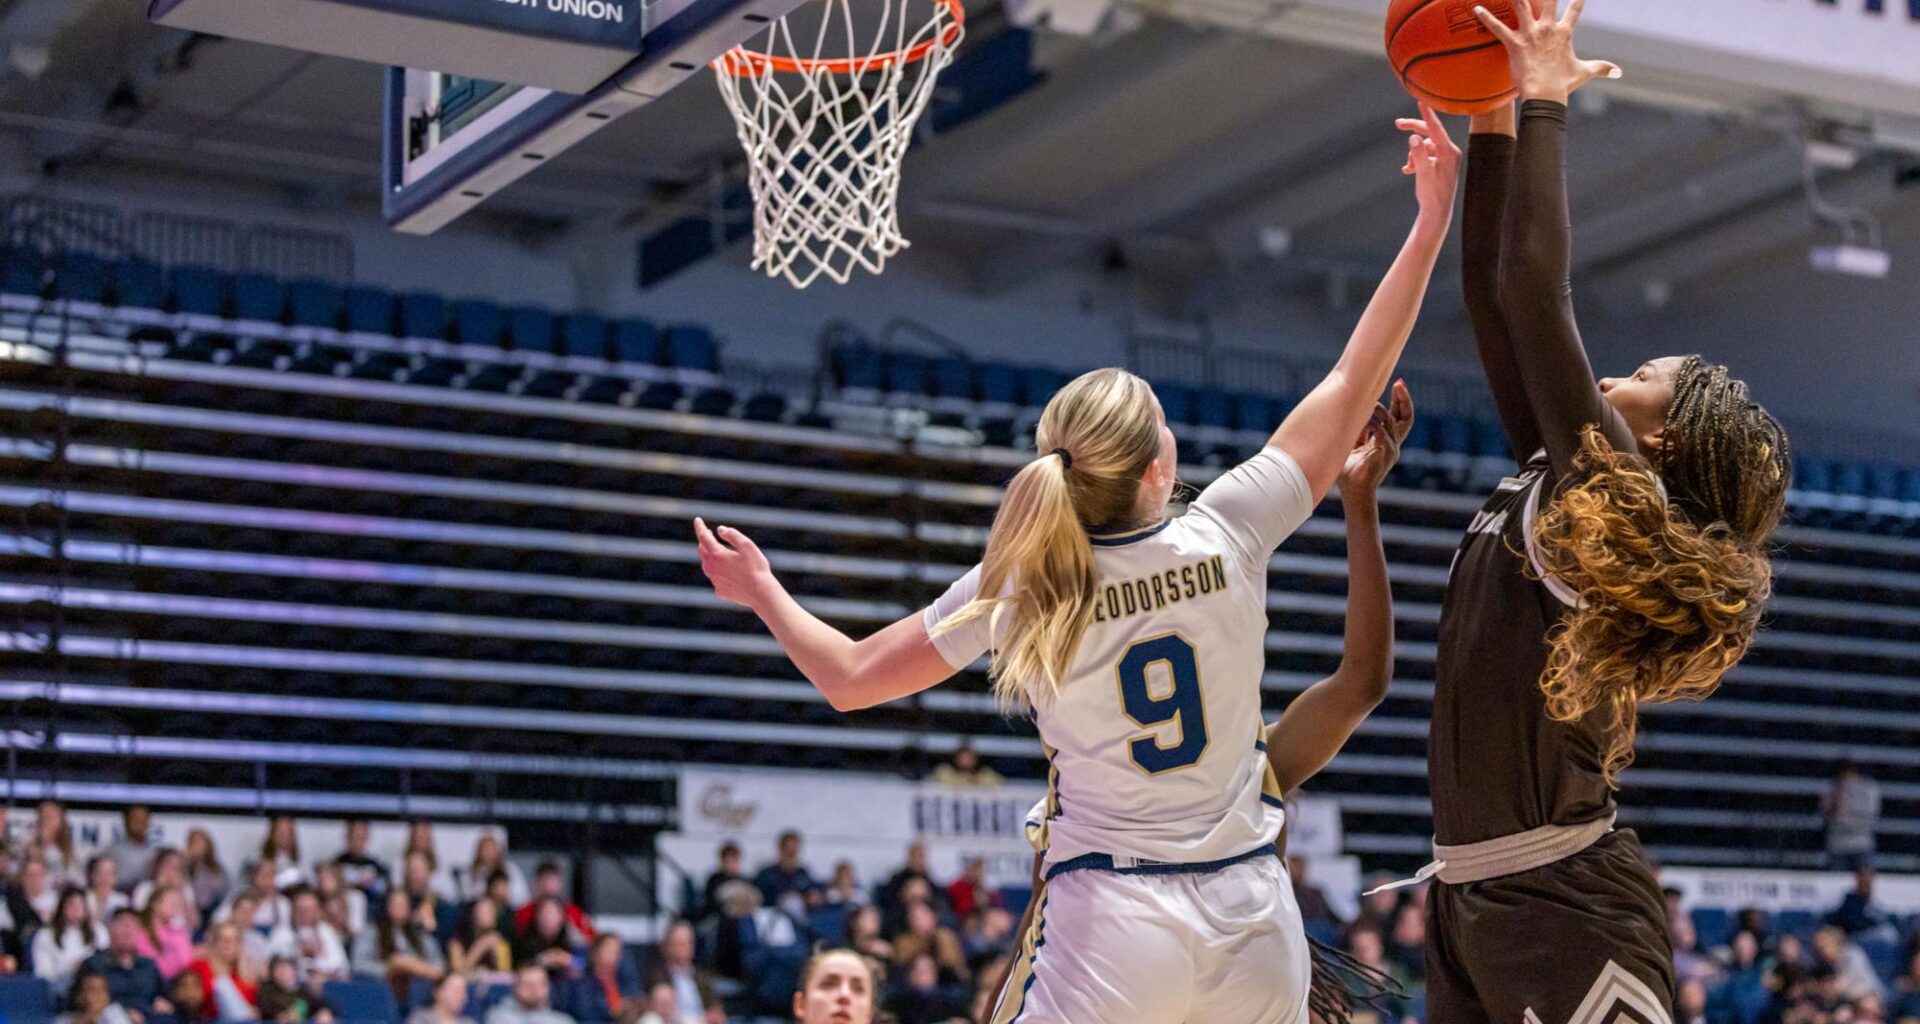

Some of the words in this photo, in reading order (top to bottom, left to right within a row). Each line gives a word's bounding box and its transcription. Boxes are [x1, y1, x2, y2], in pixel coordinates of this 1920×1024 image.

[547, 0, 623, 22] UNION
[1093, 554, 1227, 624] EODORSSON
[1115, 630, 1210, 776] 9
